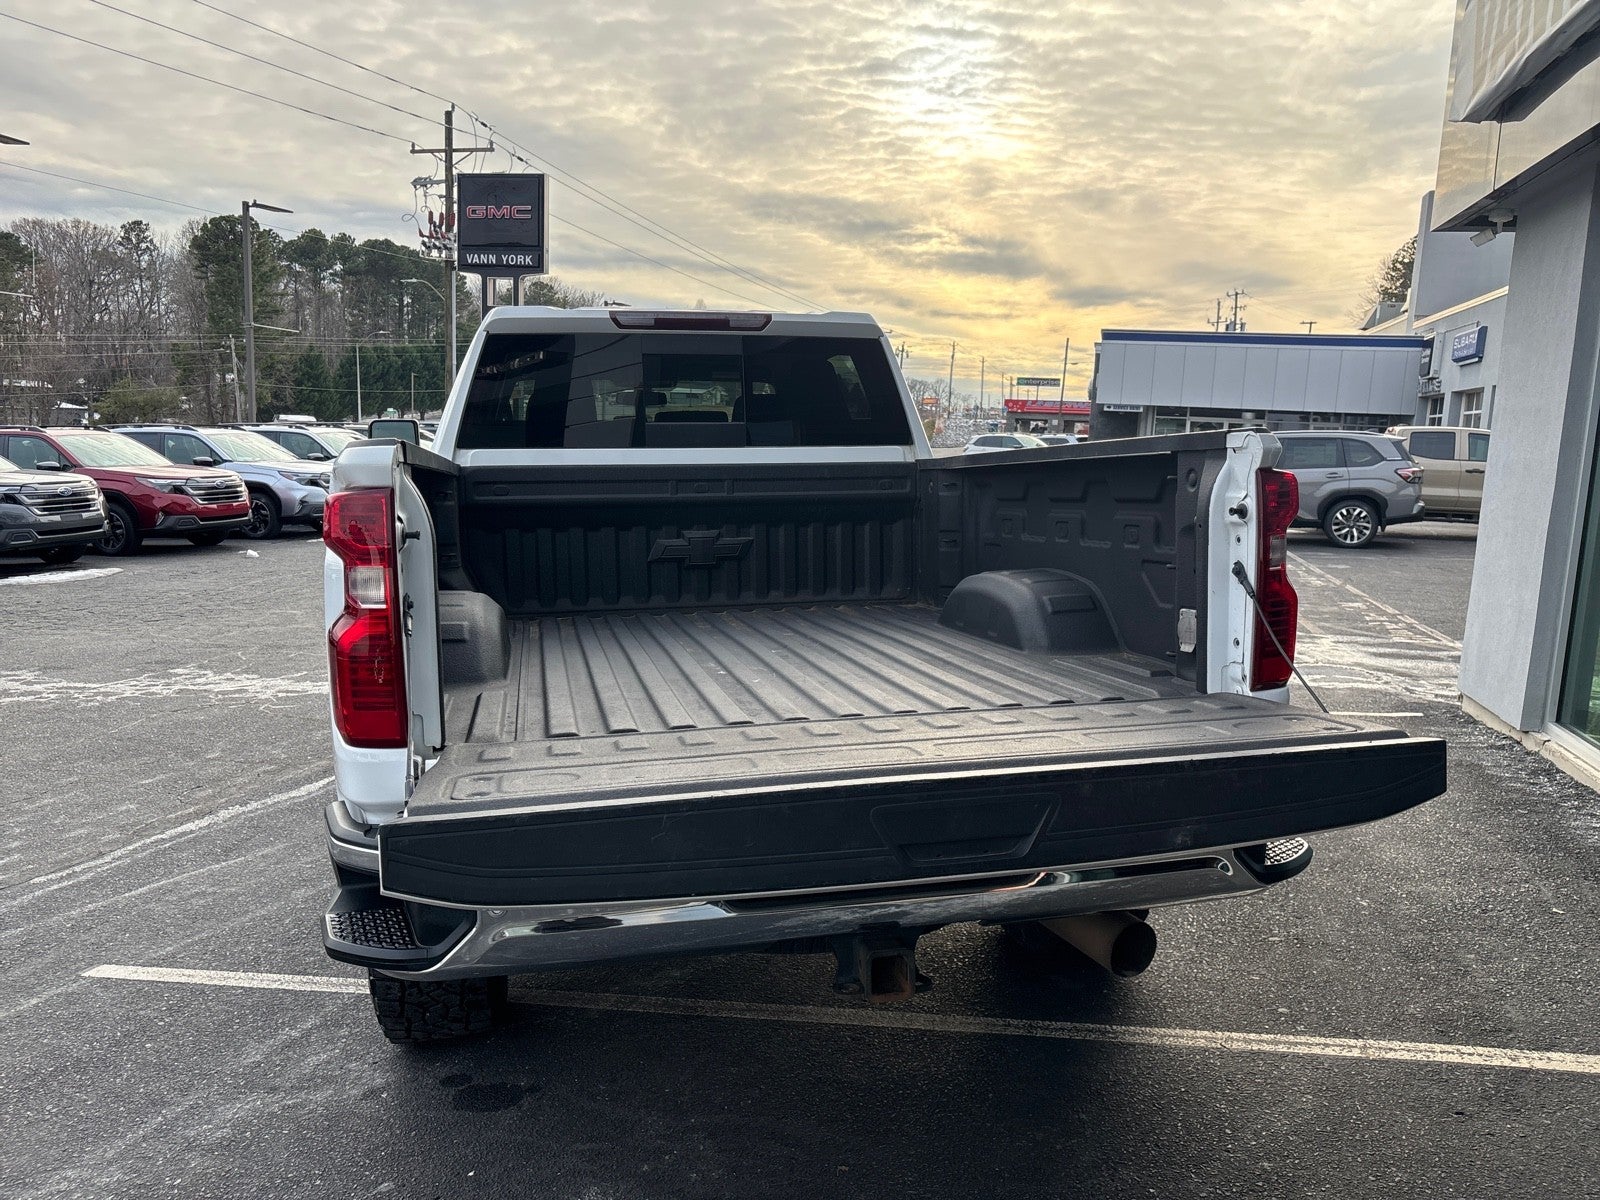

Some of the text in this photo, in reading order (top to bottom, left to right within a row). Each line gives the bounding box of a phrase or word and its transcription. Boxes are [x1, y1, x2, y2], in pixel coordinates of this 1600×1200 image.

[466, 205, 532, 219] GMC
[466, 253, 533, 265] VANN YORK
[1453, 333, 1478, 349] SUBARU
[1018, 378, 1060, 386] enterprise
